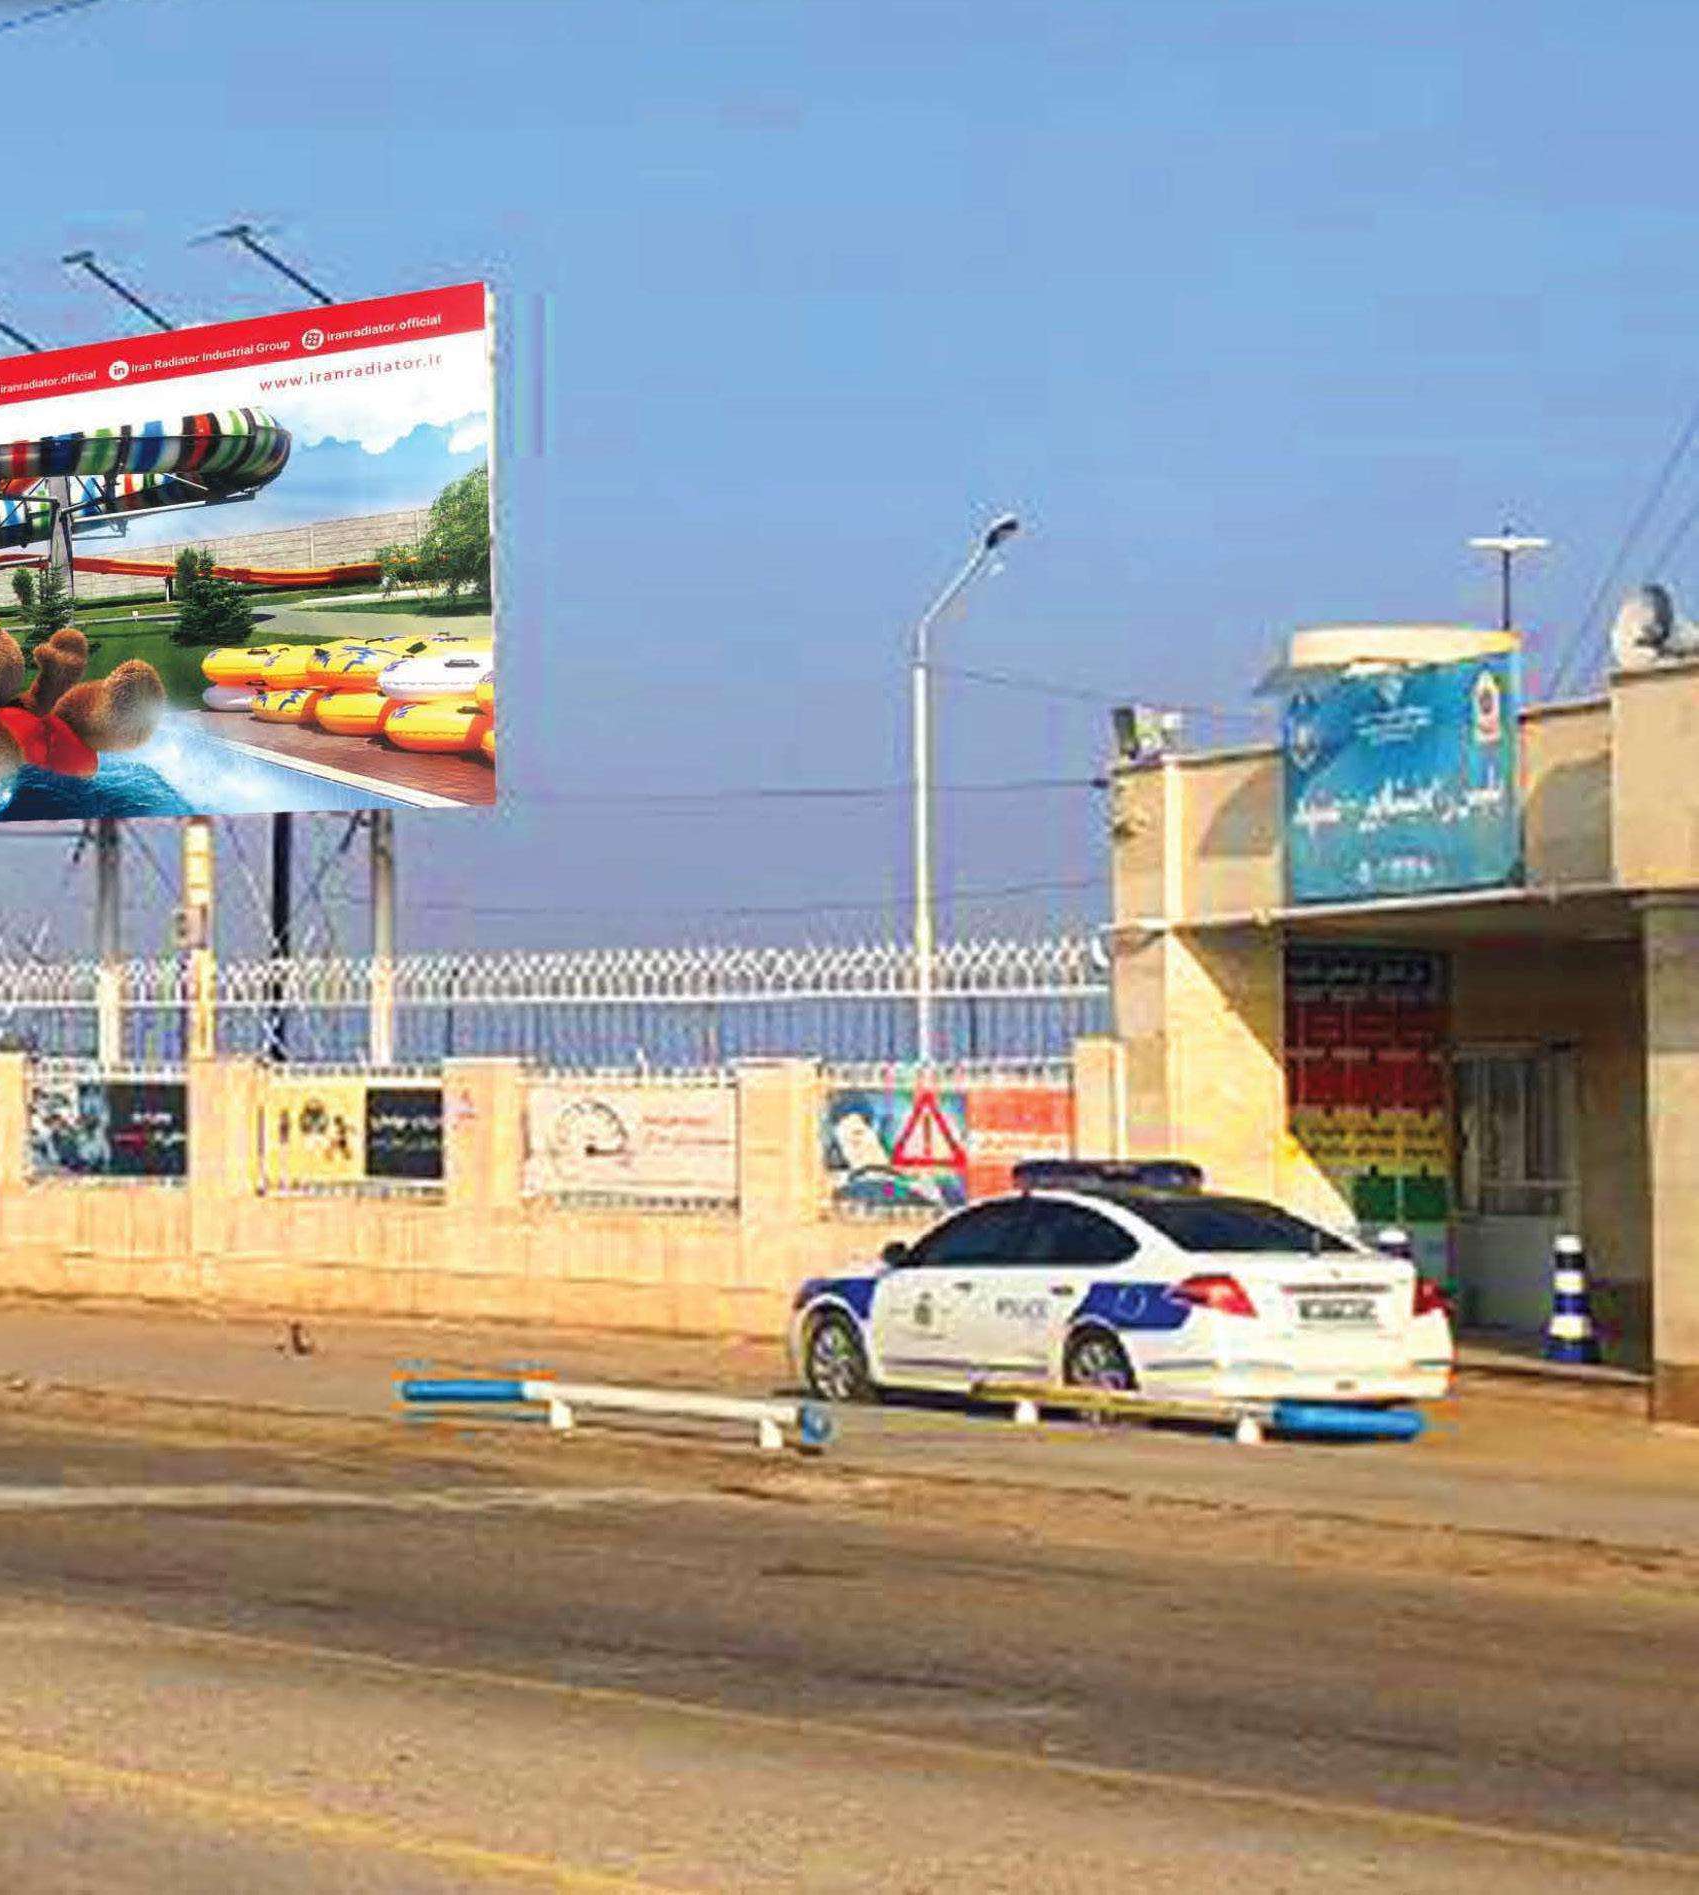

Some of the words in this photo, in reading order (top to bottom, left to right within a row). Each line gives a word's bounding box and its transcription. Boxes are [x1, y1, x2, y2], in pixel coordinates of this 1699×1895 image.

[327, 314, 442, 341] iranradiator.official
[131, 362, 152, 373] Iran
[154, 354, 199, 370] Radiator
[202, 346, 253, 362] Industrial
[256, 339, 291, 355] Group
[0, 370, 97, 394] iranradiator.official
[259, 353, 442, 391] www.iranradiator.ir
